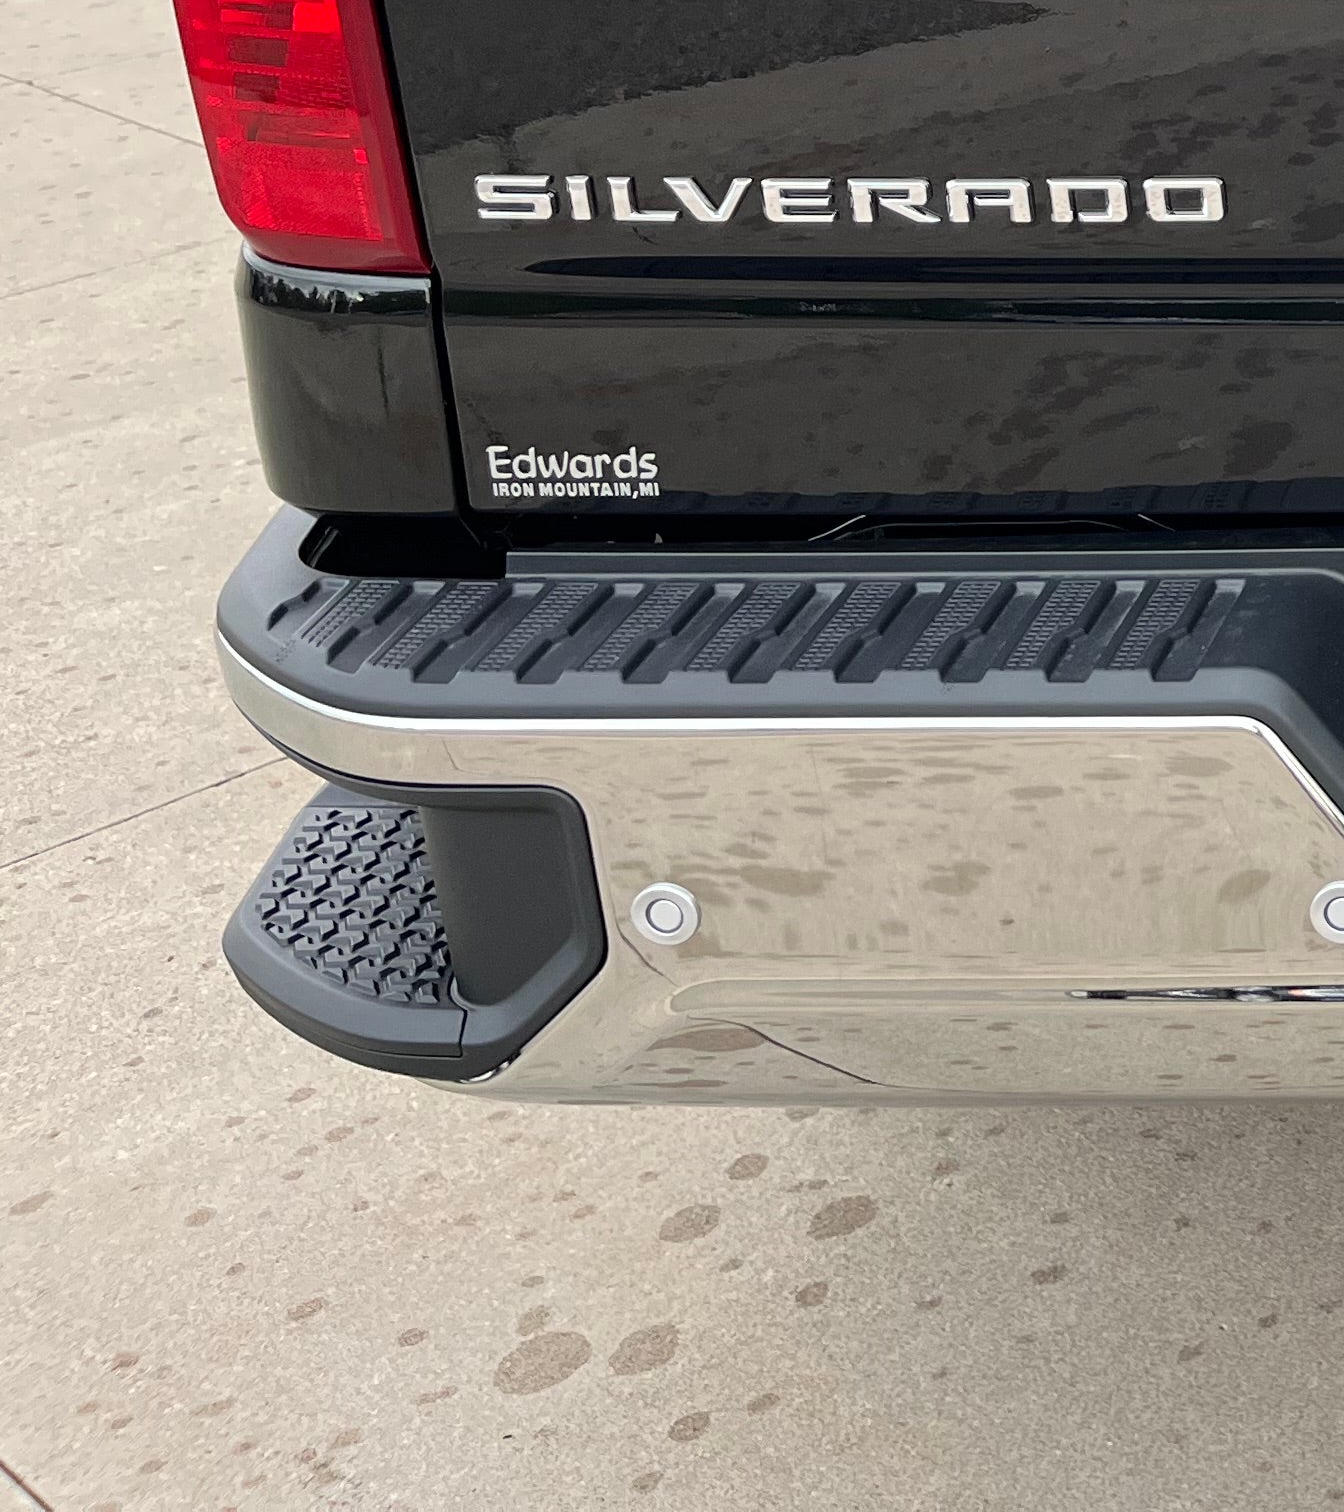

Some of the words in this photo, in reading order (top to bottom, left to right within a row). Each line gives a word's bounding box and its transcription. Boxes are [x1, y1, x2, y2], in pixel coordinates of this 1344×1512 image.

[473, 173, 1228, 224] SILVERADO
[485, 445, 658, 479] Edwards
[492, 482, 535, 497] IRON
